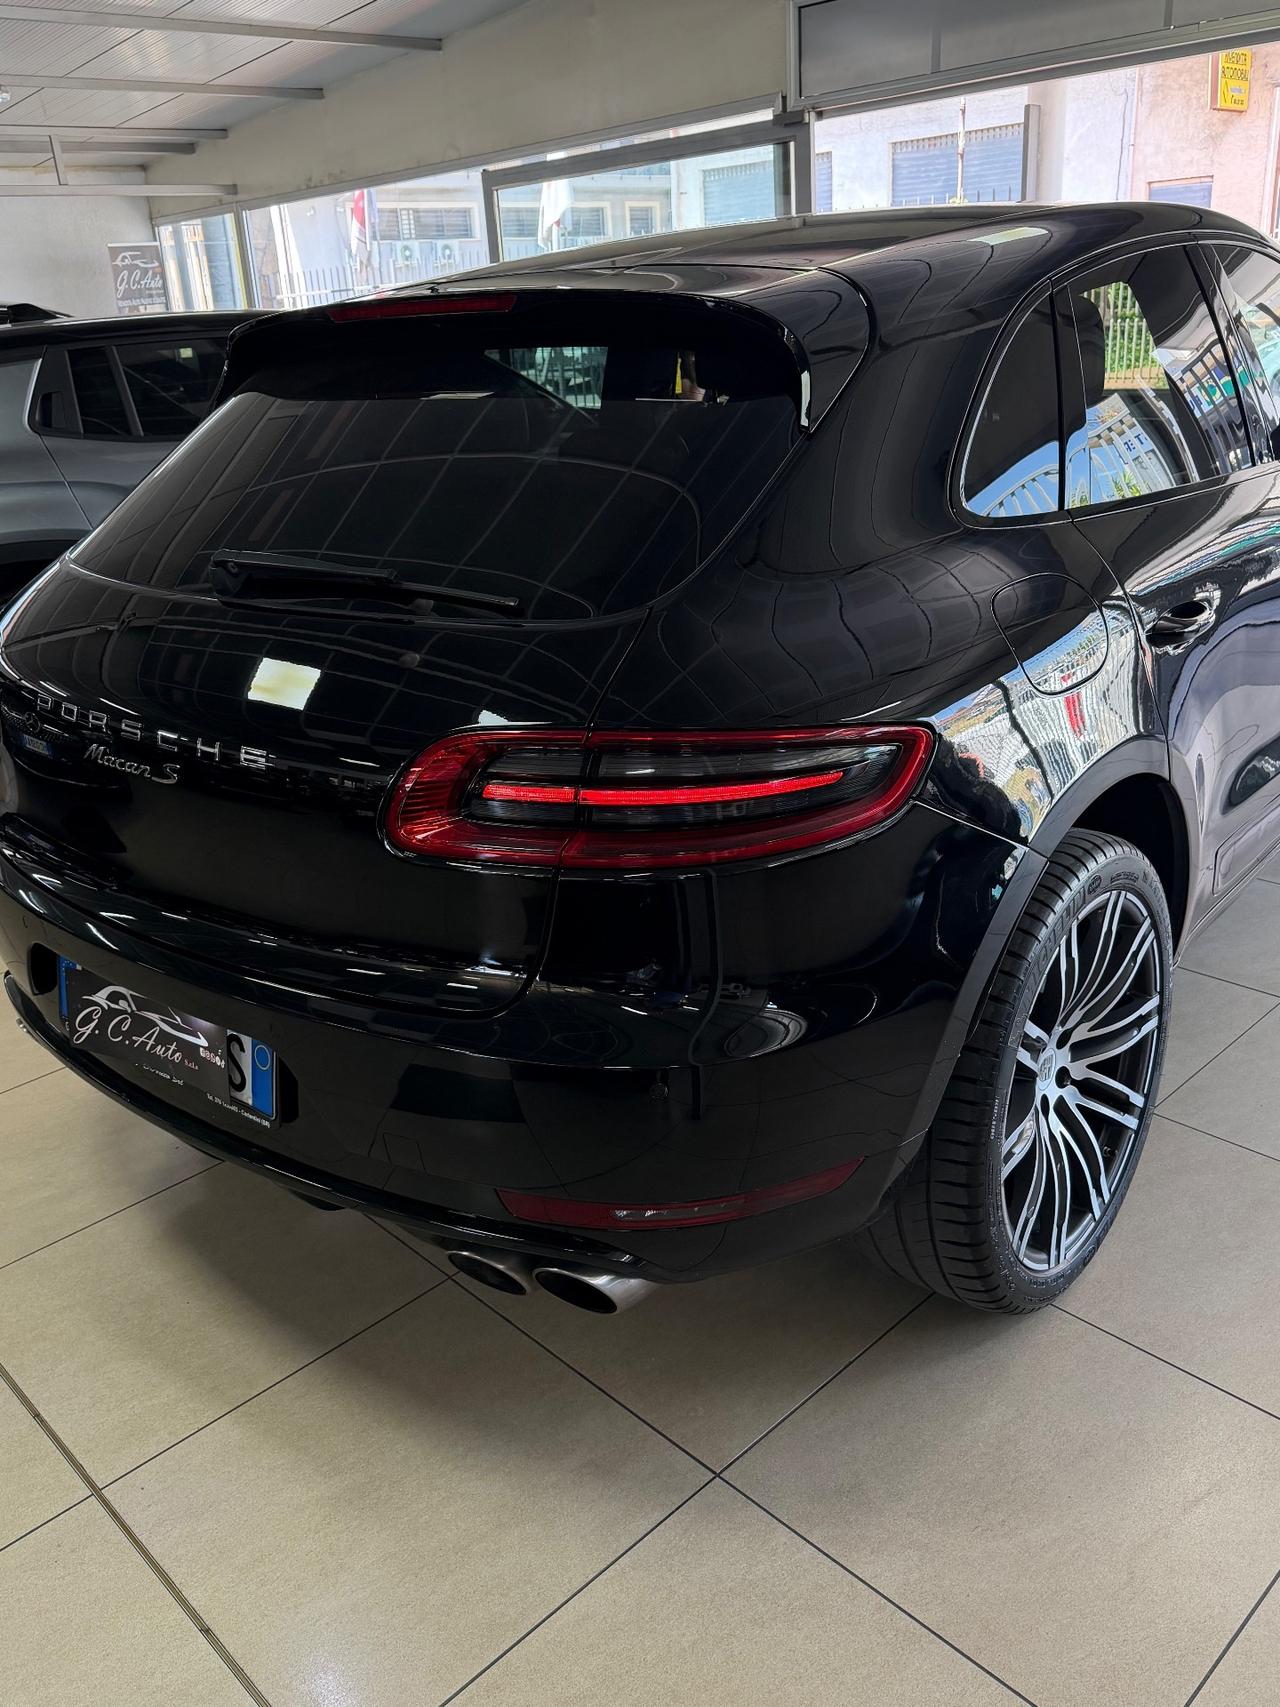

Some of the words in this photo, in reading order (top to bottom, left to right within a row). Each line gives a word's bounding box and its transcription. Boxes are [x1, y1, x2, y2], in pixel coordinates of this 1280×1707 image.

[36, 693, 267, 770] PORSCHE
[83, 743, 151, 778] Macan
[151, 763, 181, 784] S
[132, 1026, 182, 1063] Auto
